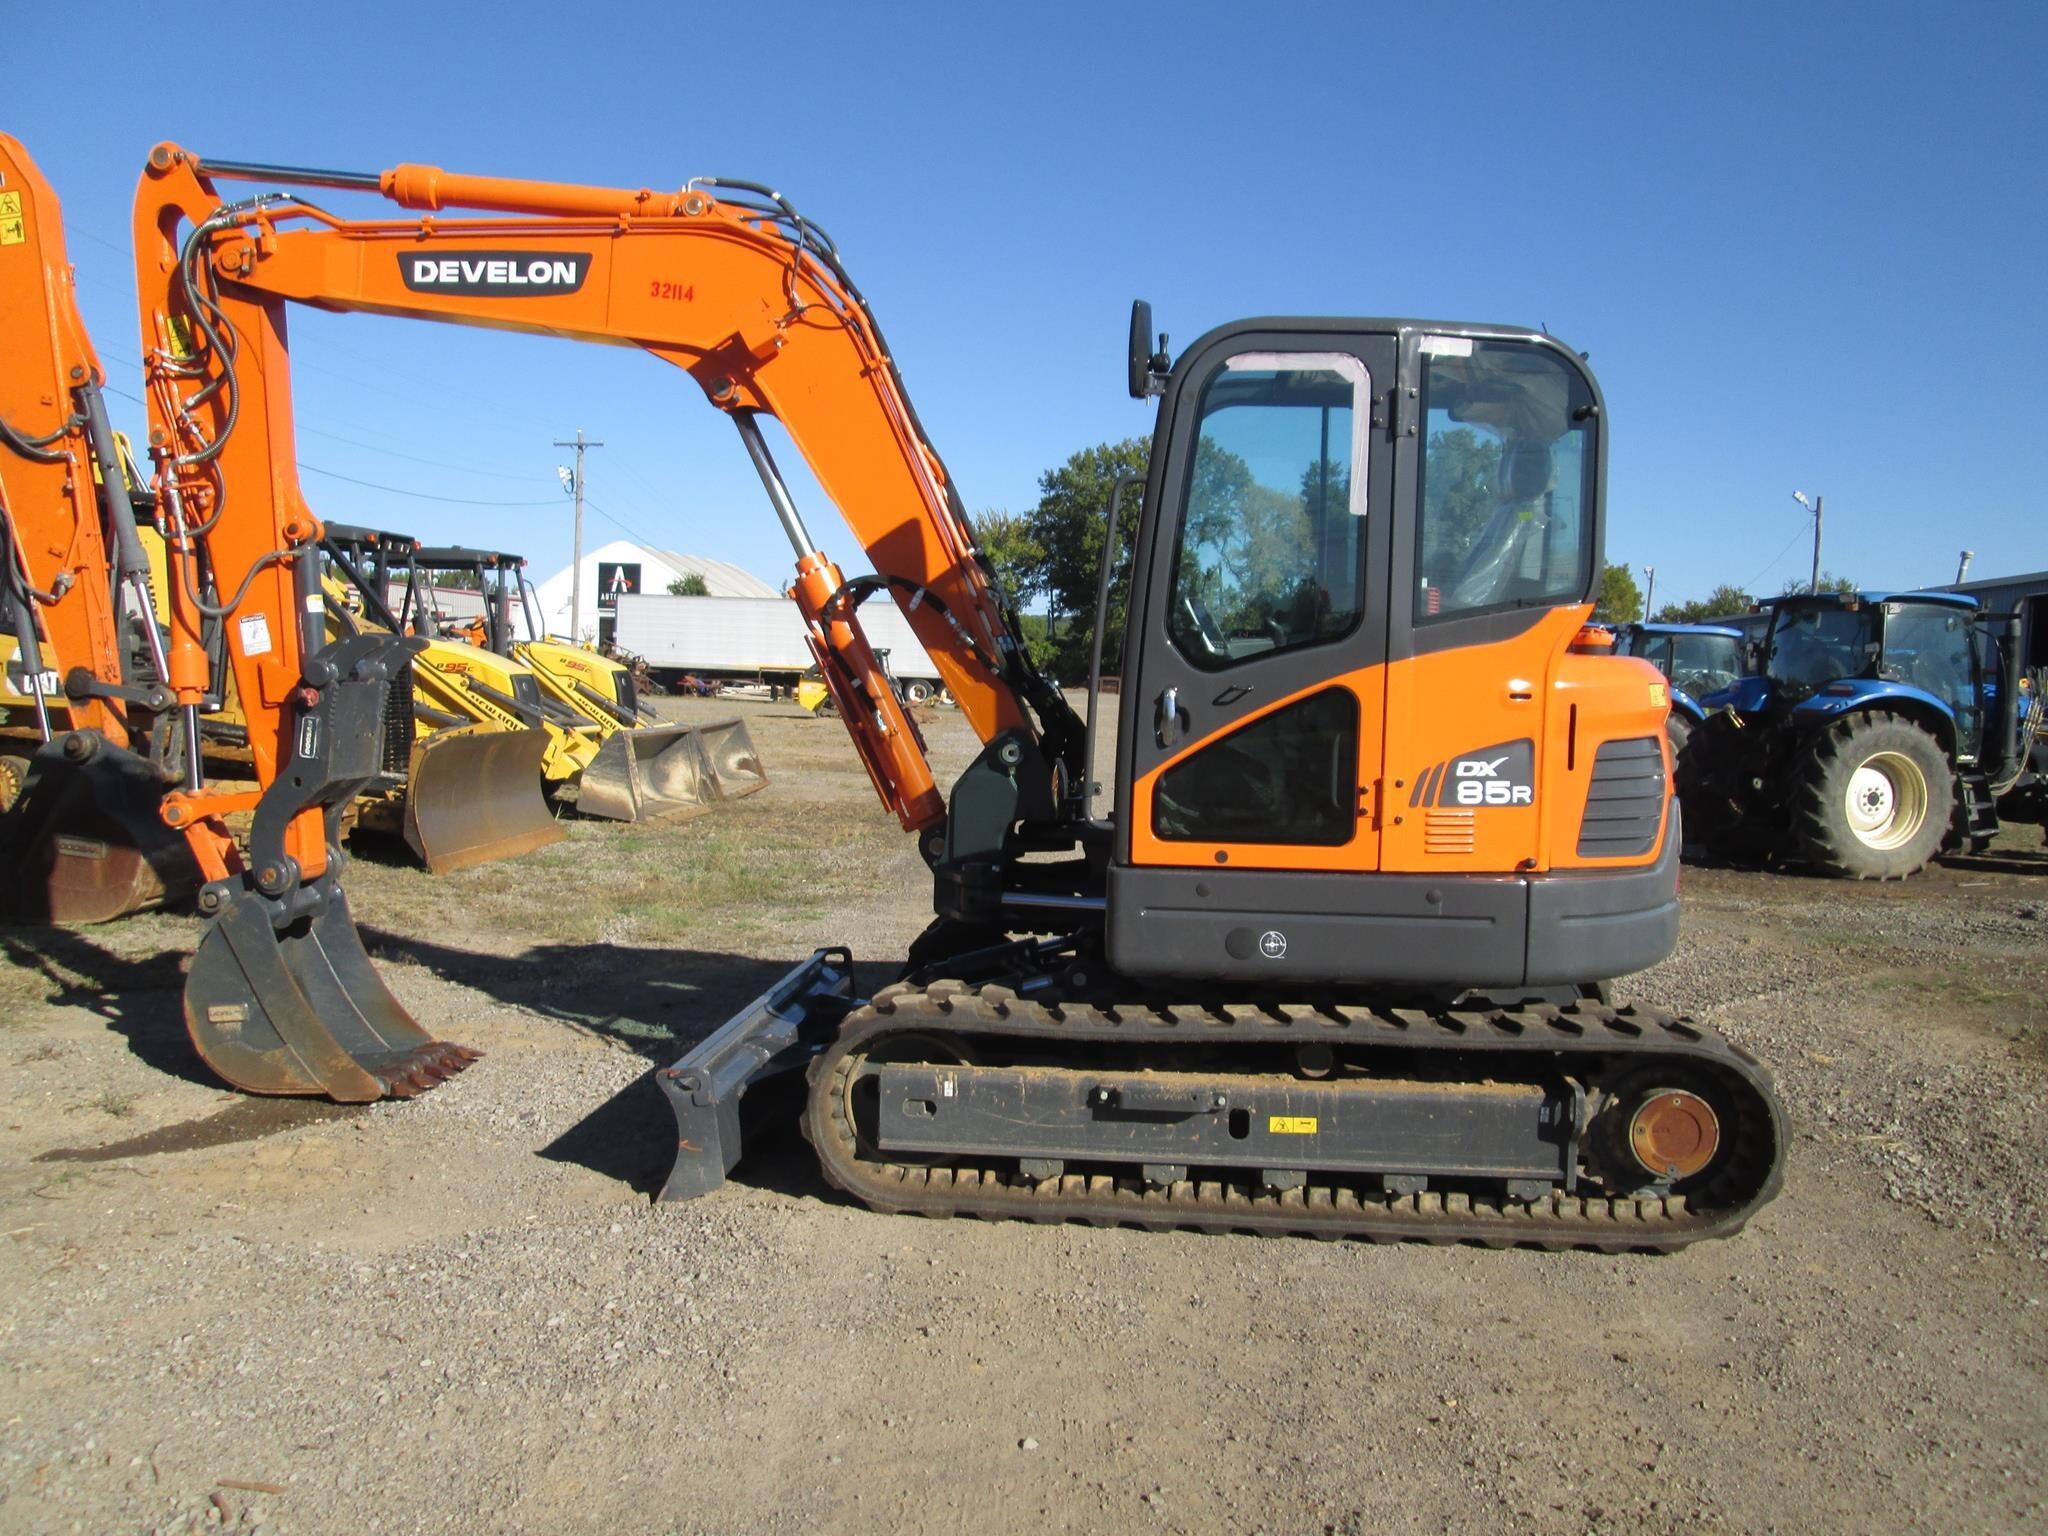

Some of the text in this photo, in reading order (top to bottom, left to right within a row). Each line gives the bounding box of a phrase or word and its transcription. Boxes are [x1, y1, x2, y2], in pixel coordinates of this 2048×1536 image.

[413, 260, 577, 284] DEVELON
[650, 281, 694, 302] 32114
[1456, 756, 1510, 776] DX
[1456, 780, 1532, 804] 85R
